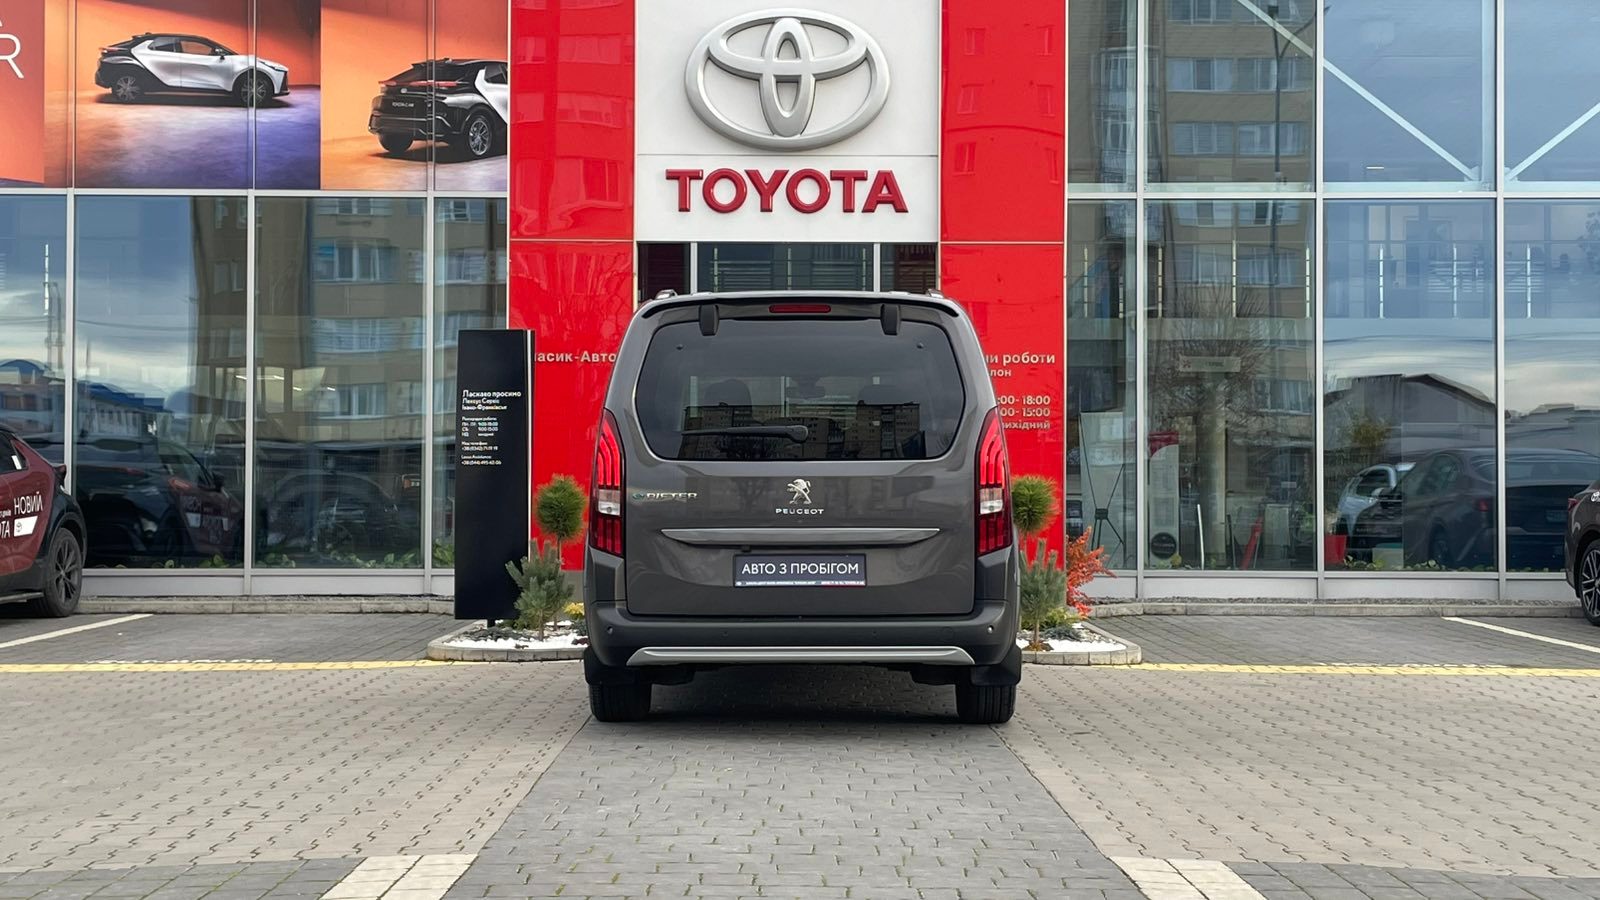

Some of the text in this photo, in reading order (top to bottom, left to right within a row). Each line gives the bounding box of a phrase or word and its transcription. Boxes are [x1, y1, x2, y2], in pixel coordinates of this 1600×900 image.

[665, 168, 909, 214] TOYOTA
[534, 350, 616, 363] асик-Авто
[1002, 351, 1056, 367] роботи
[990, 369, 1012, 377] лон
[1022, 395, 1051, 405] 18:00
[1022, 407, 1051, 417] 15:00
[13, 491, 43, 515] НОВИЙ
[0, 520, 11, 539] TA
[741, 562, 859, 575] АВТО З ПРОБІГОМ
